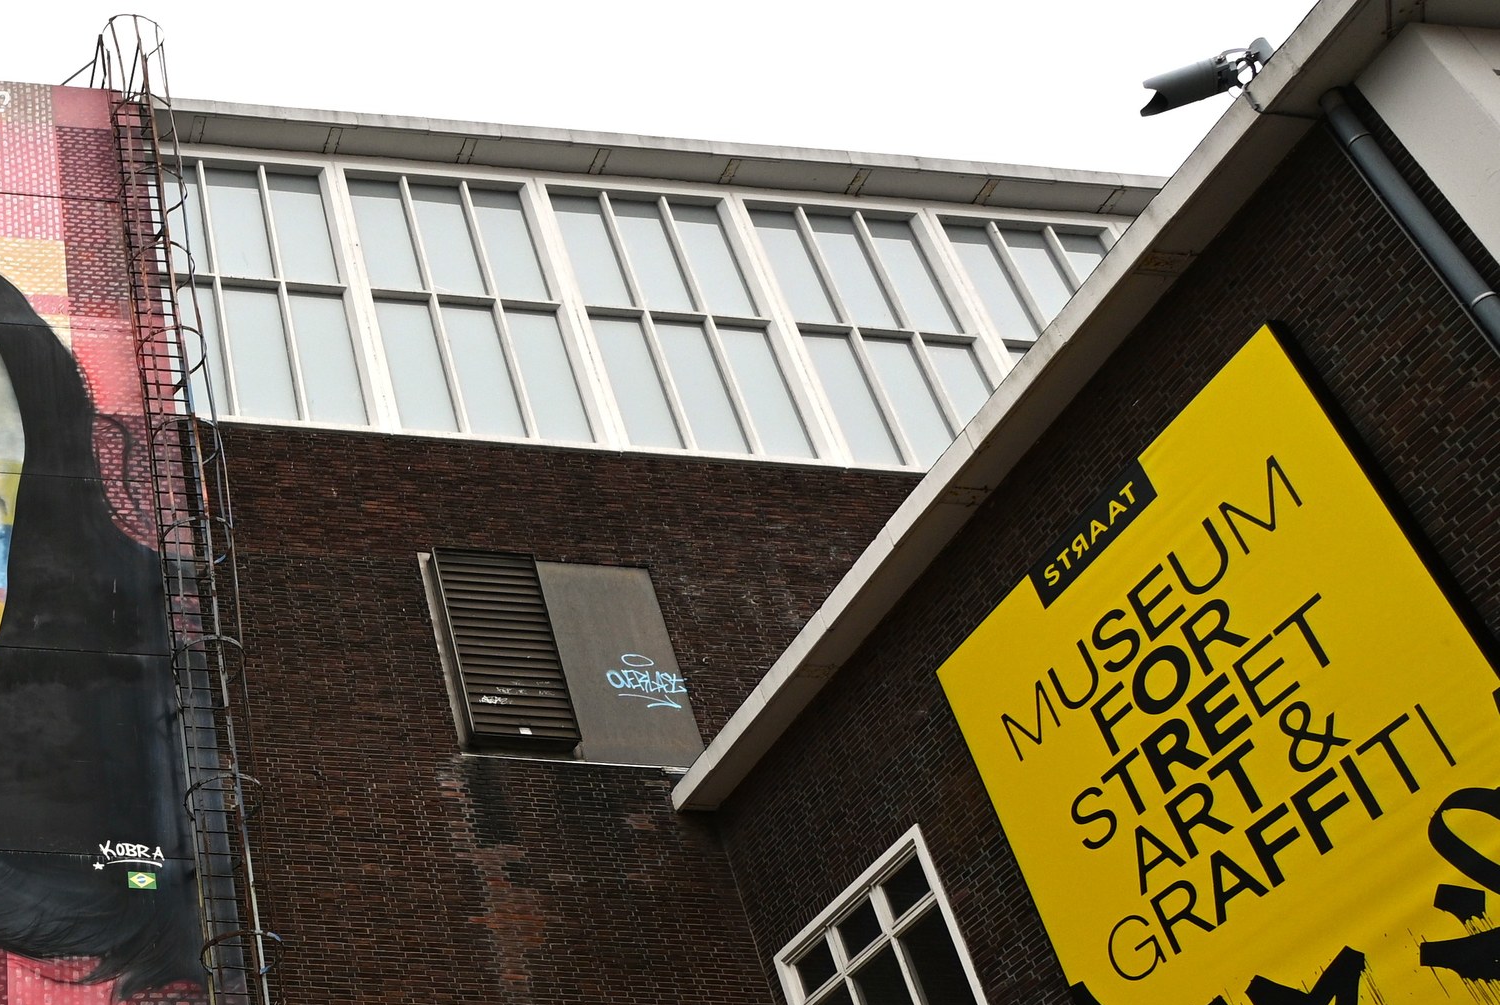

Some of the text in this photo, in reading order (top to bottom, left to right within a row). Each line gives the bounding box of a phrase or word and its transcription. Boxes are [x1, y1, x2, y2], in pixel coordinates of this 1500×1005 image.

[1000, 454, 1303, 763] MUSEUM
[1070, 592, 1332, 851] STREET
[1090, 598, 1251, 755] FOR
[99, 840, 166, 862] KOBRA
[1107, 703, 1457, 982] GRAFFITI
[1133, 700, 1352, 896] ART &
